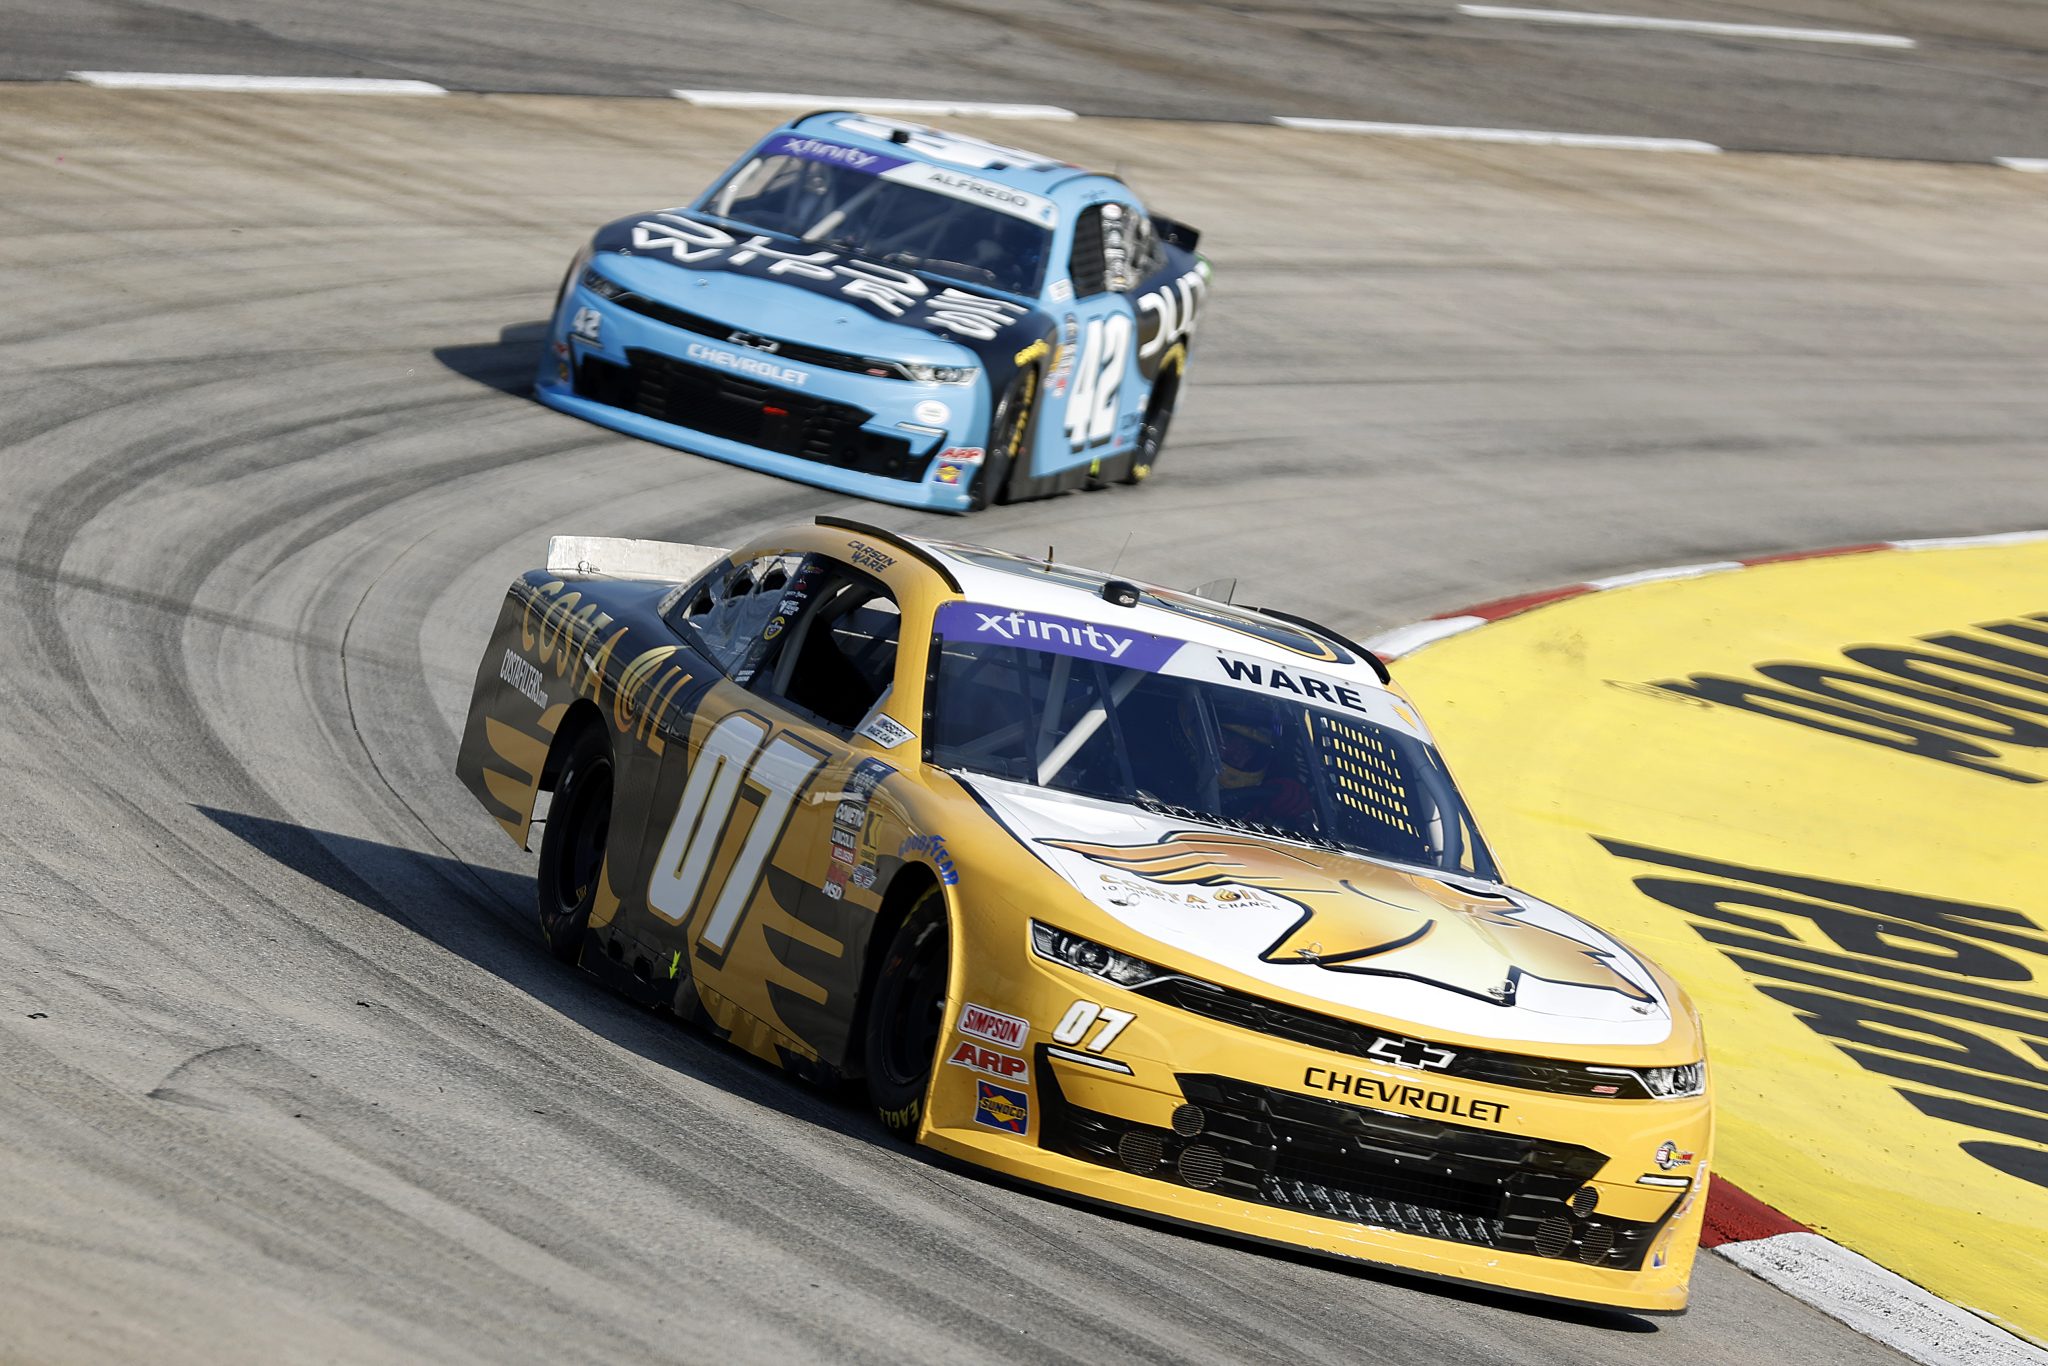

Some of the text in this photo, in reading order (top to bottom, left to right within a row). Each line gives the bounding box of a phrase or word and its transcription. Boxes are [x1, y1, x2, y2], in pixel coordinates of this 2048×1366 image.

[784, 137, 880, 169] xfinity
[928, 171, 1028, 208] ALFREDO
[572, 306, 602, 338] 42
[687, 343, 810, 387] CHEVROLET
[1064, 314, 1132, 450] 42
[847, 540, 898, 567] CARSON
[851, 550, 888, 573] WARE
[522, 581, 629, 706] COSTA
[975, 610, 1134, 659] xfinity
[1216, 655, 1368, 713] WARE
[646, 708, 830, 954] 07
[1218, 901, 1281, 911] CHANGE
[963, 1008, 1023, 1044] SIMPSON
[1051, 998, 1138, 1054] 07
[952, 1045, 1027, 1078] ARP
[980, 1097, 1027, 1120] SUNOCO
[1303, 1066, 1510, 1124] CHEVROLET
